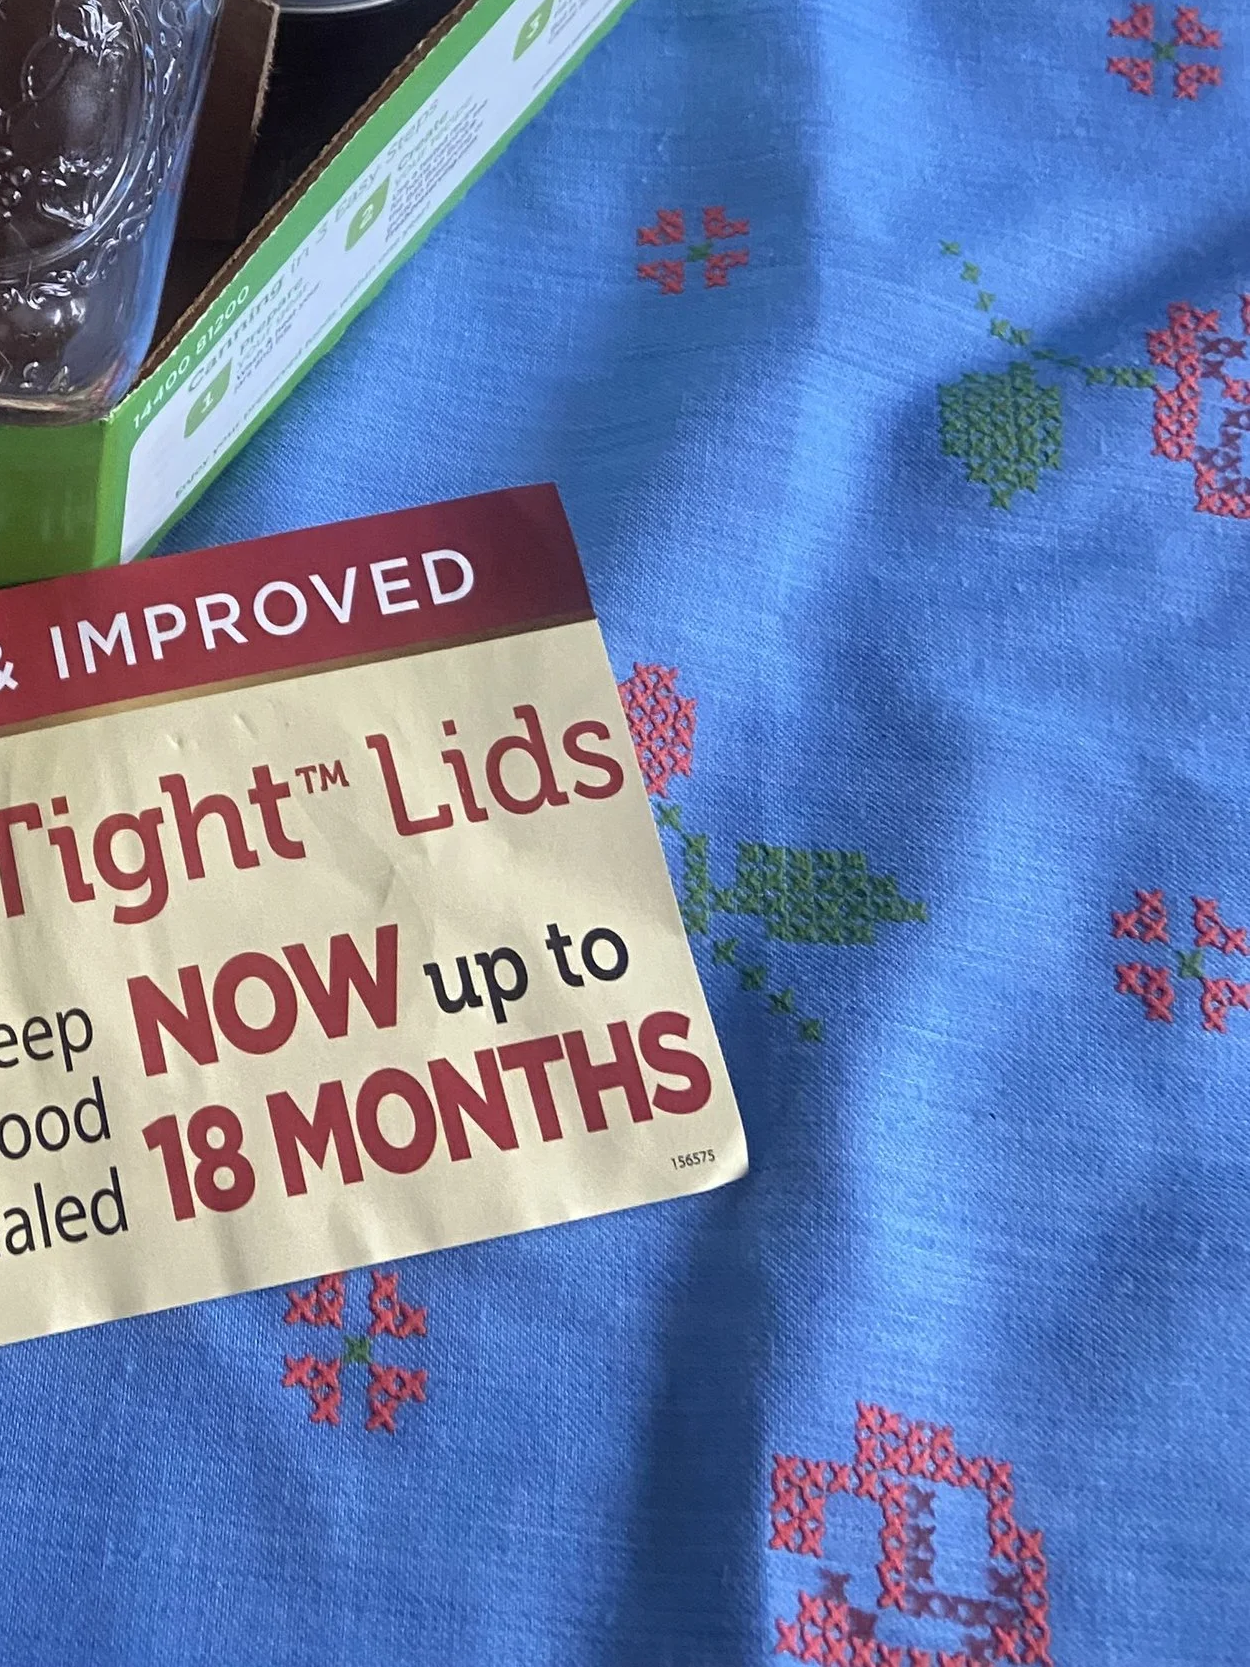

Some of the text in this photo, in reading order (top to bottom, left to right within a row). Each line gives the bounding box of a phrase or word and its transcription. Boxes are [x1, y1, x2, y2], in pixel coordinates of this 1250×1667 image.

[359, 204, 374, 230] 2
[133, 285, 250, 429] 14400 81200
[189, 276, 285, 391] Canning
[201, 393, 214, 412] 1
[49, 548, 475, 680] IMPROVED
[366, 704, 625, 837] Lids
[126, 923, 630, 1076] NOW up to
[142, 1011, 713, 1221] 18 MONTHS
[671, 1149, 716, 1170] 156575
